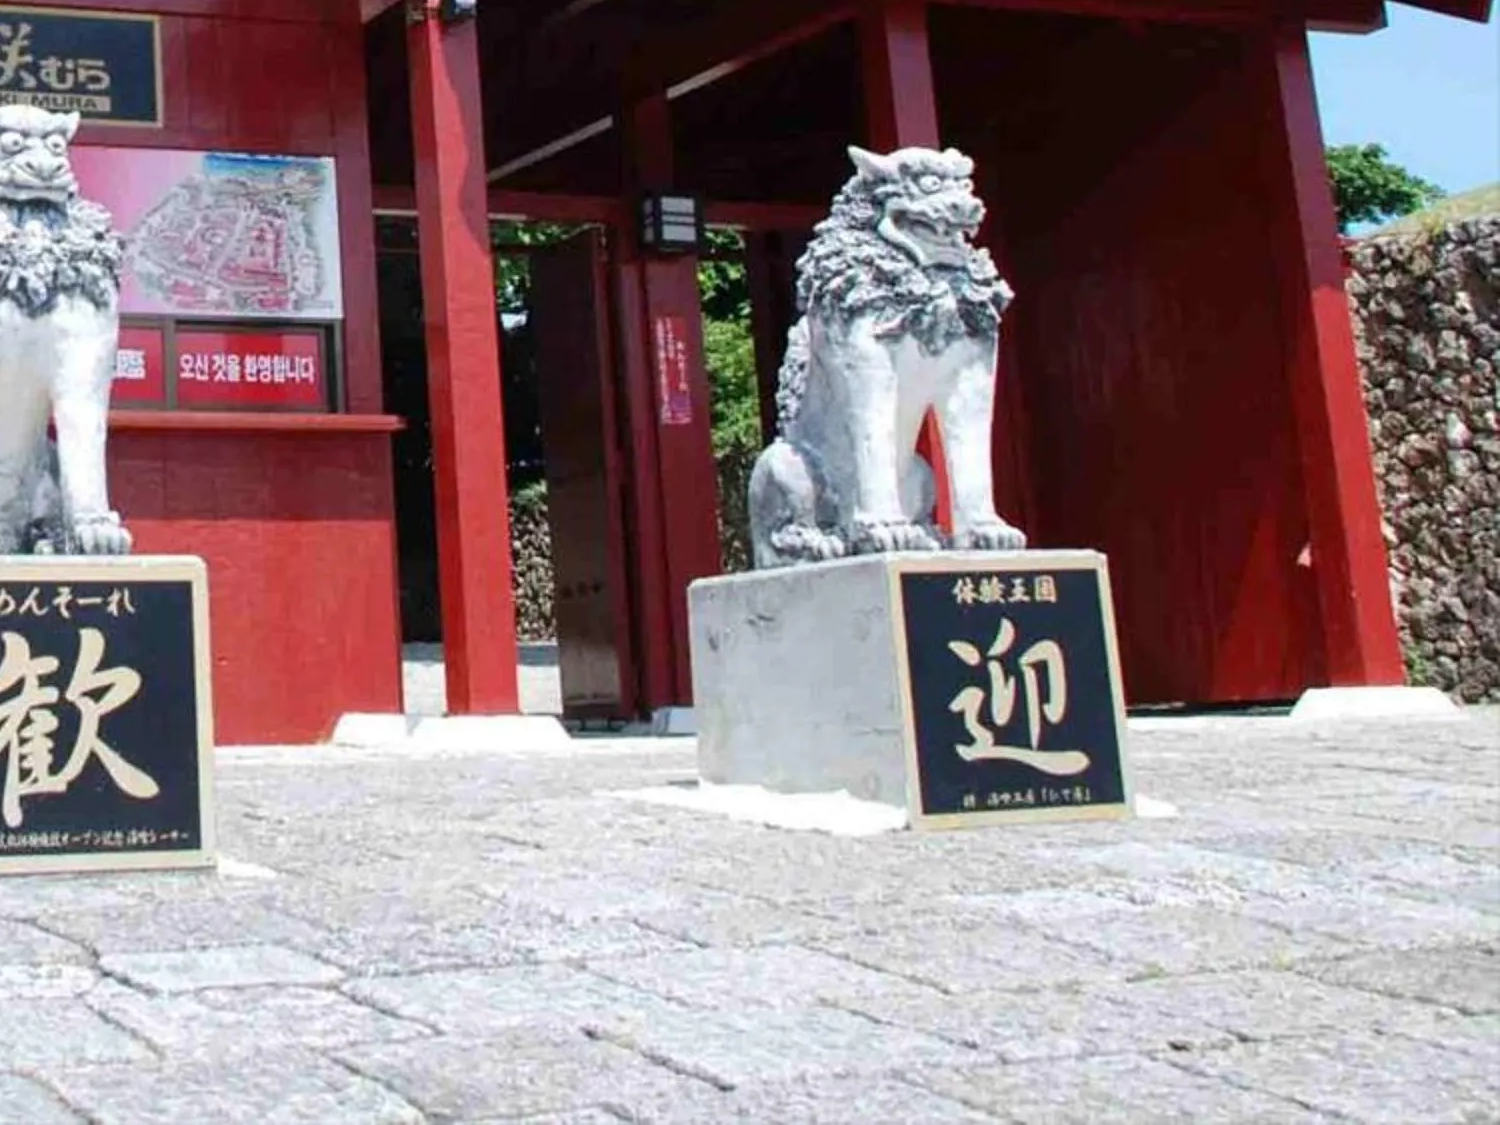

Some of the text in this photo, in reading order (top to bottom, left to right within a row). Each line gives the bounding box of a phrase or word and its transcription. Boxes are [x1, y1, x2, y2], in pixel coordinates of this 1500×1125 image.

[30, 94, 99, 110] MURA
[179, 353, 315, 385] 오신 것을 환영합니다
[947, 617, 1092, 776] 迎
